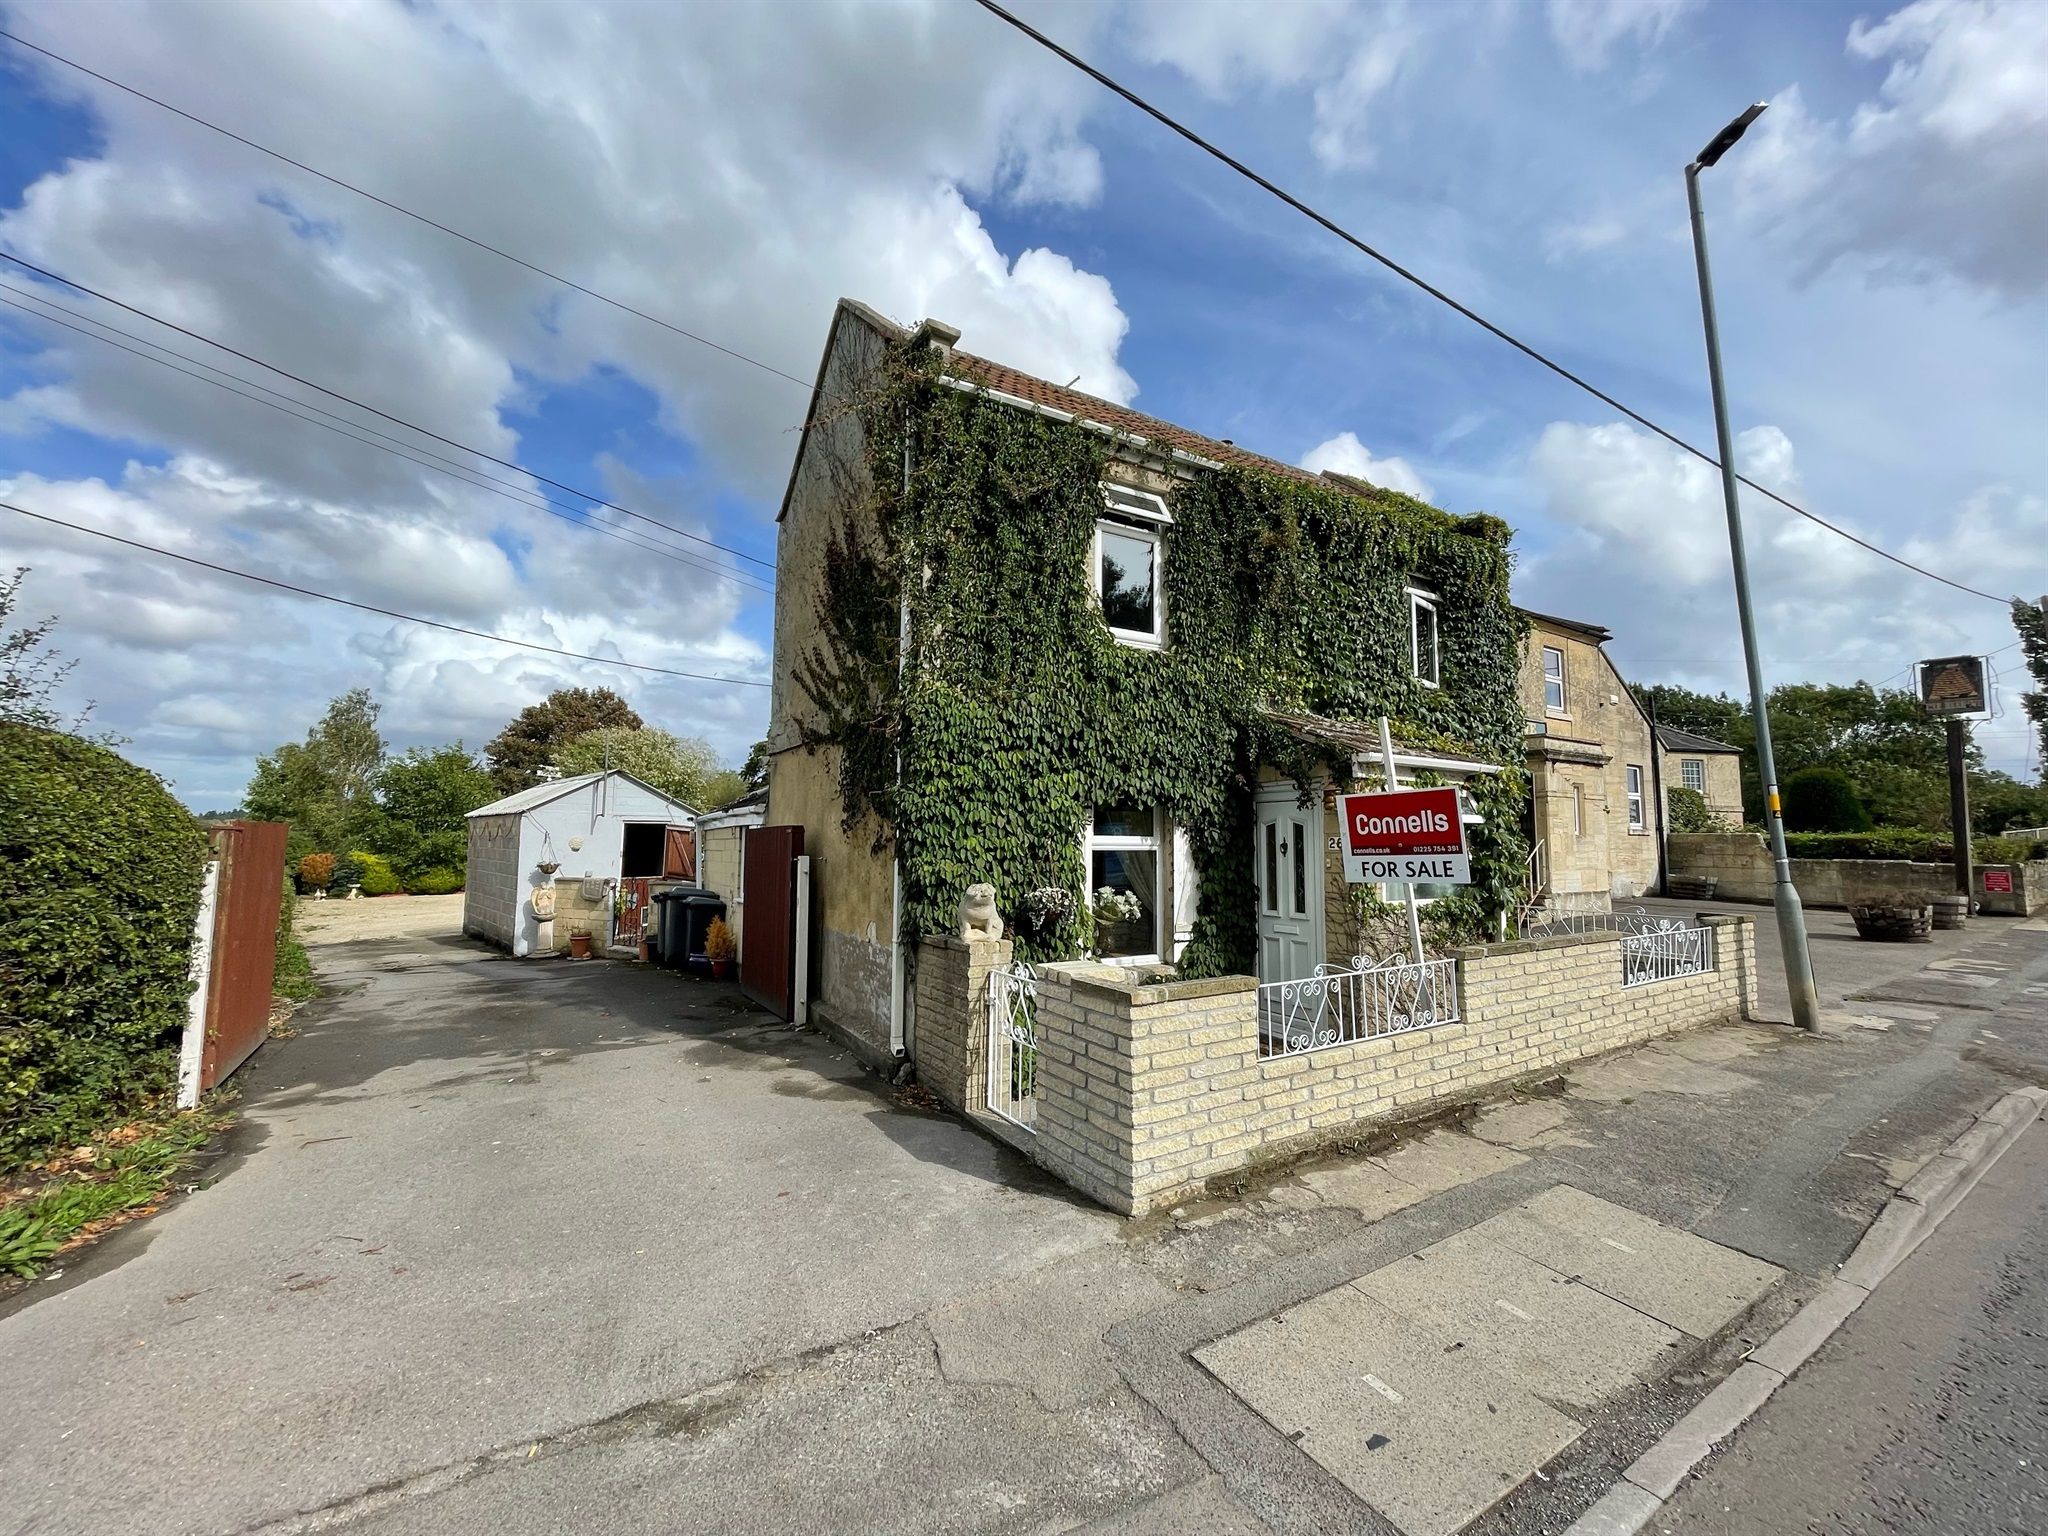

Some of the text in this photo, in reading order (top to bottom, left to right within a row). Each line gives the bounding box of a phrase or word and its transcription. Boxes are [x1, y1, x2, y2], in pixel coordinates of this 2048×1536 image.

[1356, 810, 1449, 835] Connells
[1361, 860, 1455, 878] FOR SALE
